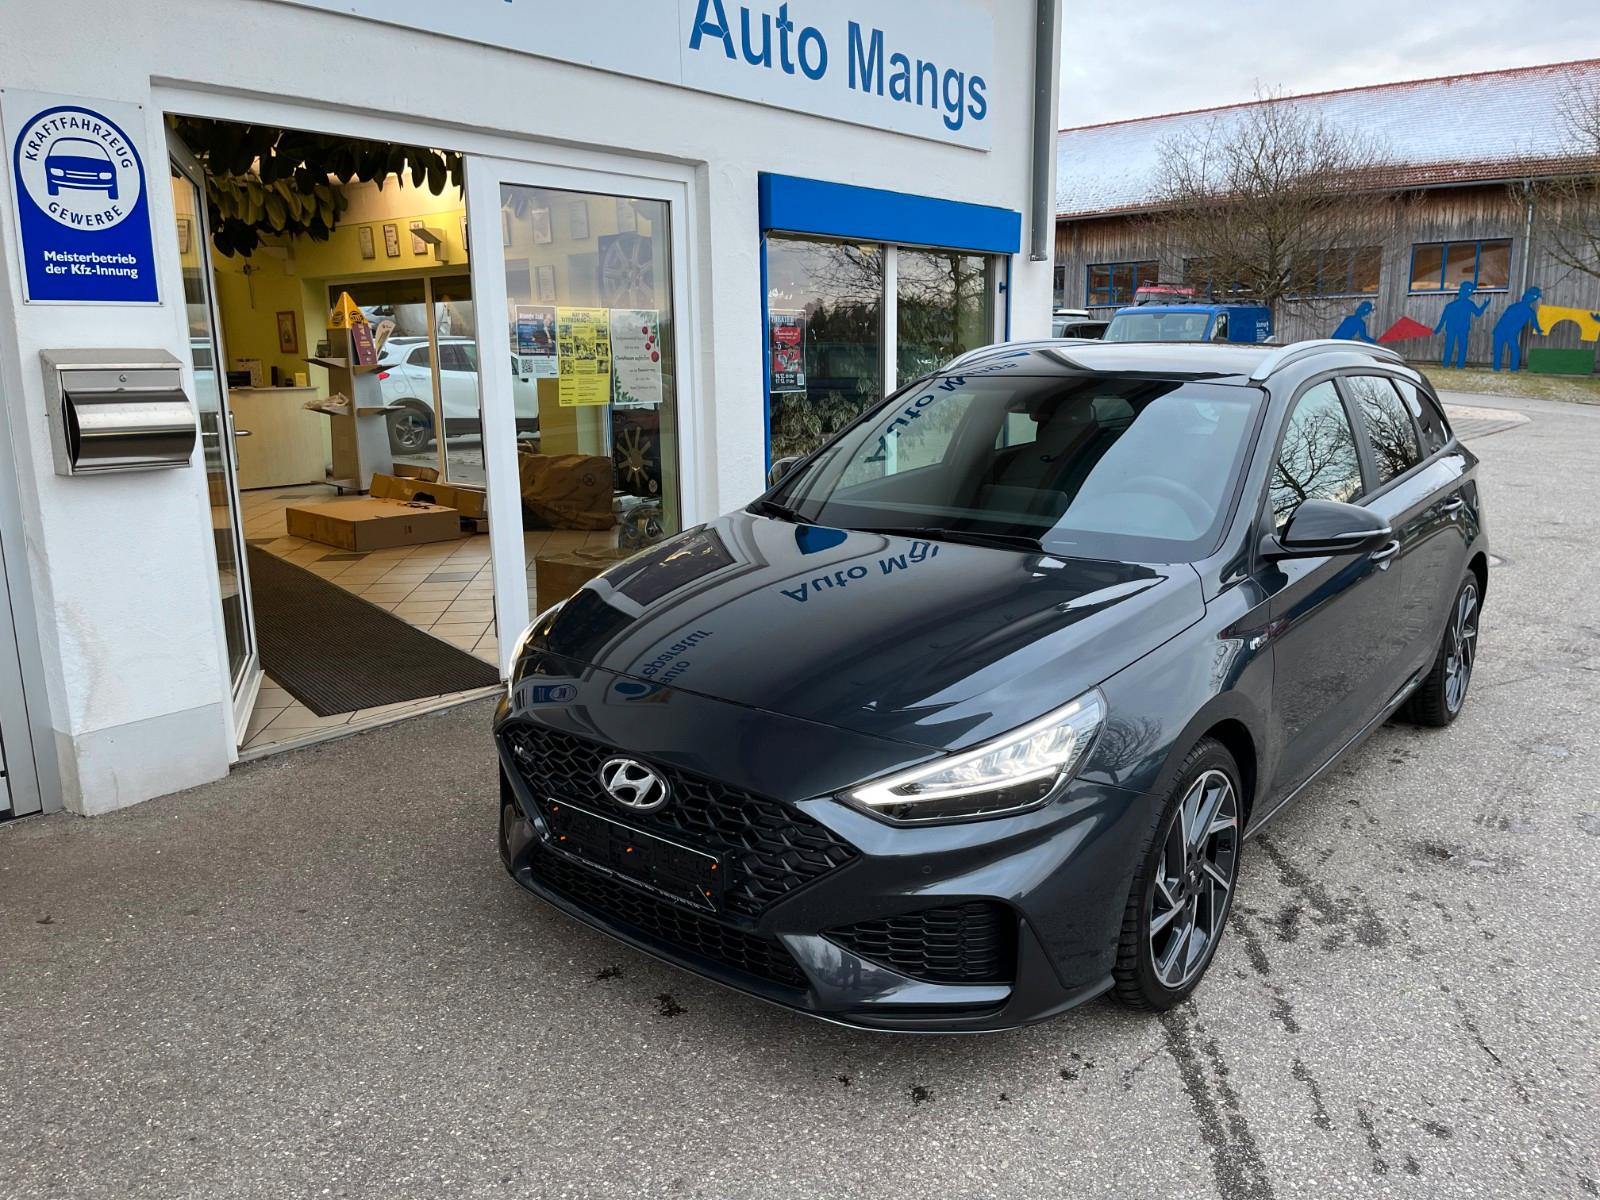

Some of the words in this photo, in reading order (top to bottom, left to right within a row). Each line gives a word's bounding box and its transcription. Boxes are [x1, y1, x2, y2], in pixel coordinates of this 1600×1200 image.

[689, 0, 828, 81] Auto
[848, 20, 987, 131] Mangs
[25, 117, 133, 169] KRAFTFAHRZEUG
[48, 201, 123, 226] GEWERBE
[44, 251, 137, 265] Meisterbetrieb
[46, 264, 67, 275] der
[71, 264, 138, 279] Kfz-Innung
